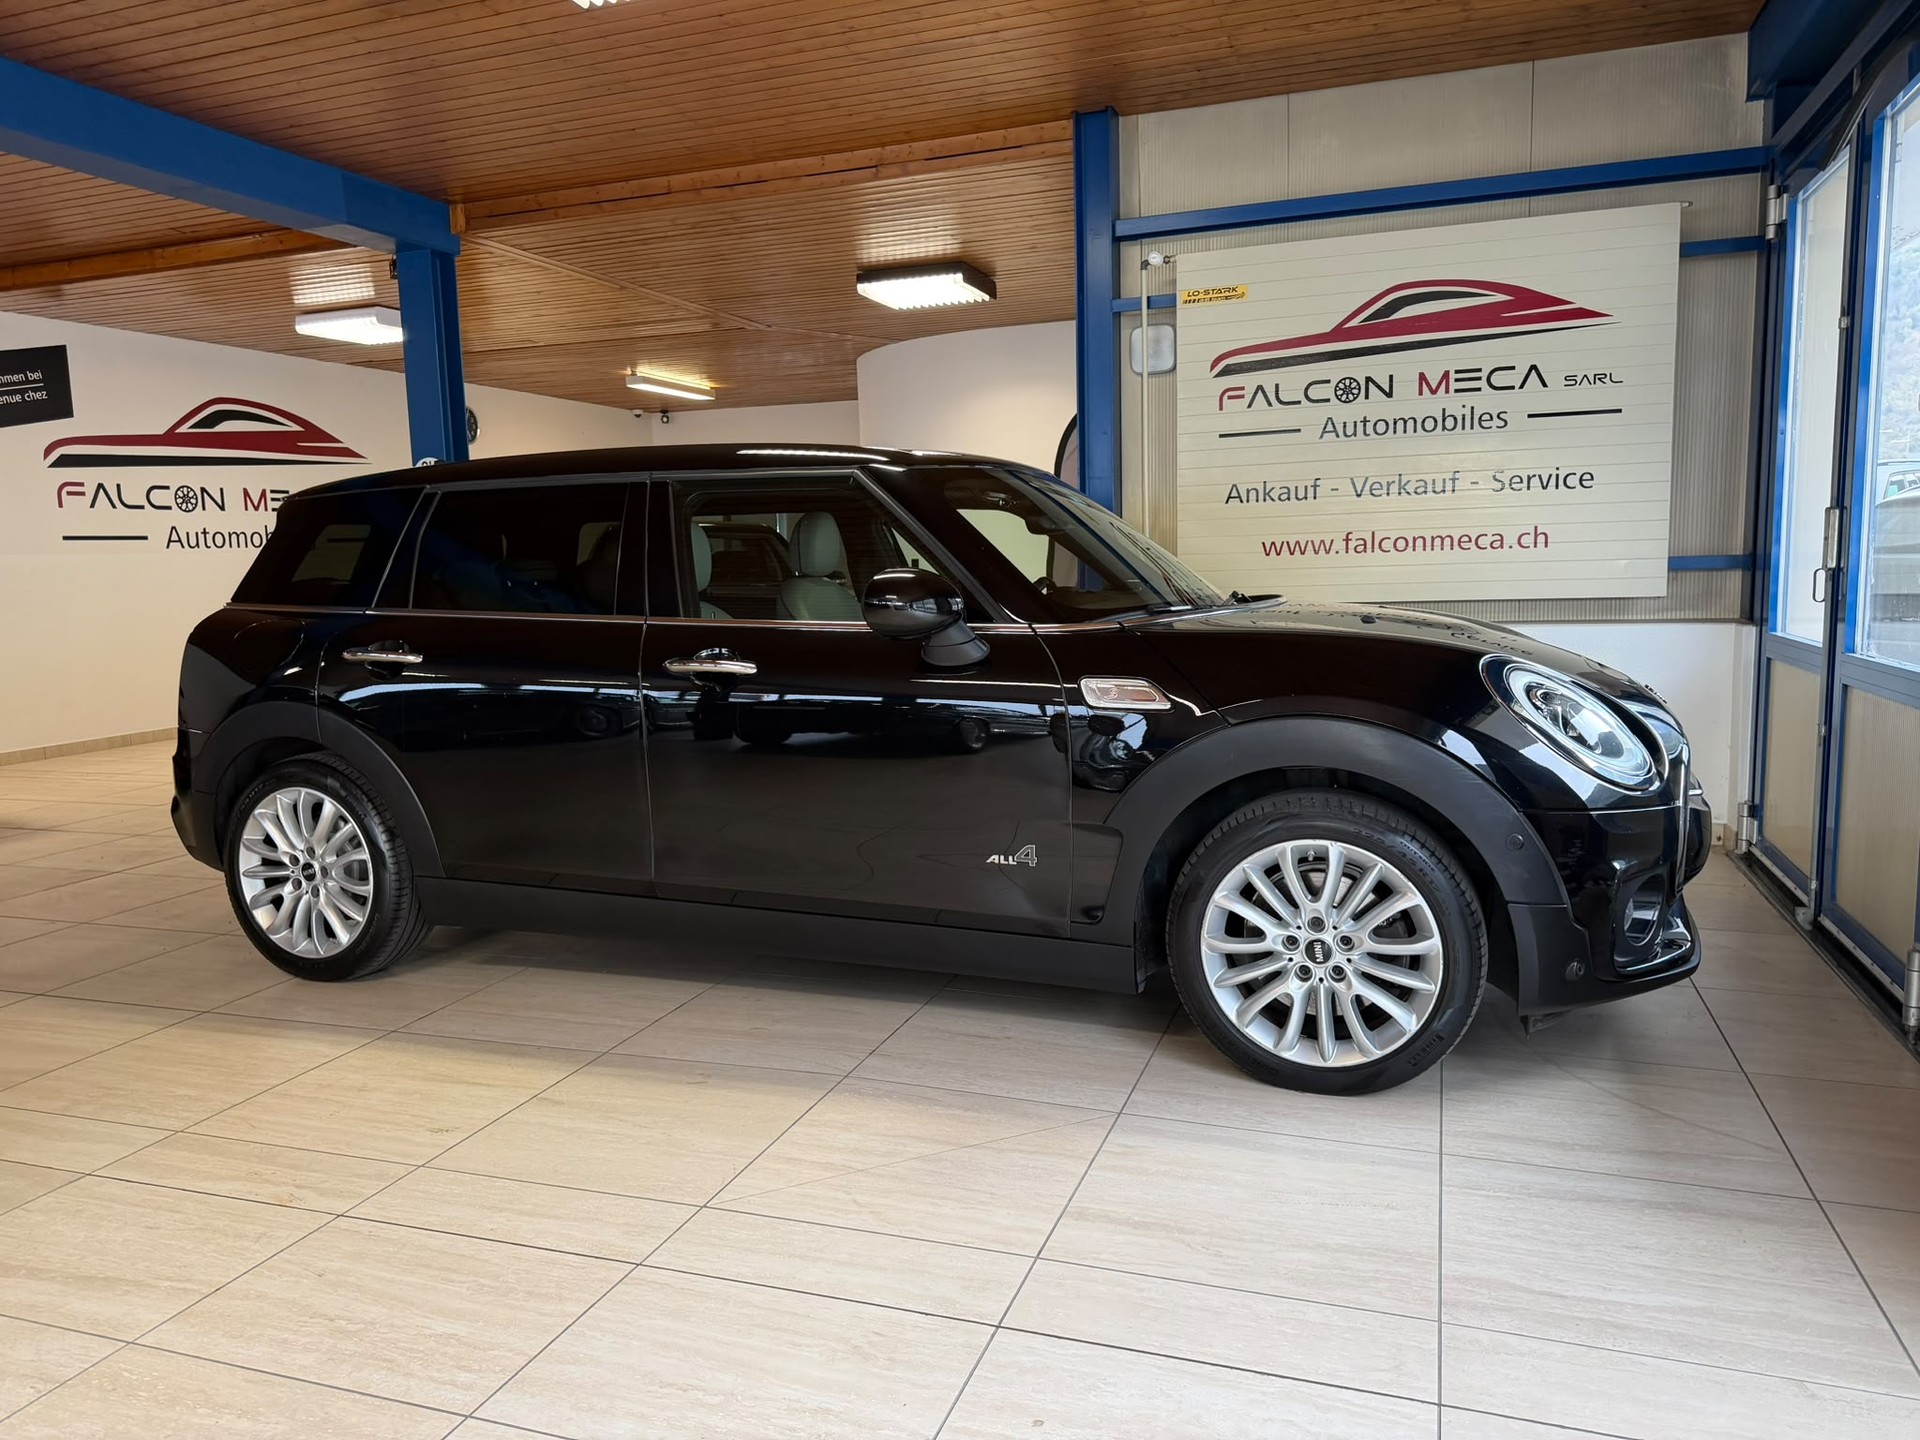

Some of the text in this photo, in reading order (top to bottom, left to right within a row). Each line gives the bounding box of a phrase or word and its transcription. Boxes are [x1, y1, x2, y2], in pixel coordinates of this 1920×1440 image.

[26, 369, 43, 381] bei
[1218, 364, 1624, 411] FALCON MECA SARL
[24, 390, 48, 401] chez
[1318, 404, 1509, 440] Automobiles
[57, 481, 226, 513] FALCON
[1225, 477, 1321, 504] Ankauf
[1350, 472, 1460, 498] Verkauf
[1491, 467, 1596, 493] Service
[1261, 525, 1549, 557] www.falconmeca.ch
[985, 844, 1038, 867] ALL4
[1313, 941, 1325, 962] MINI
